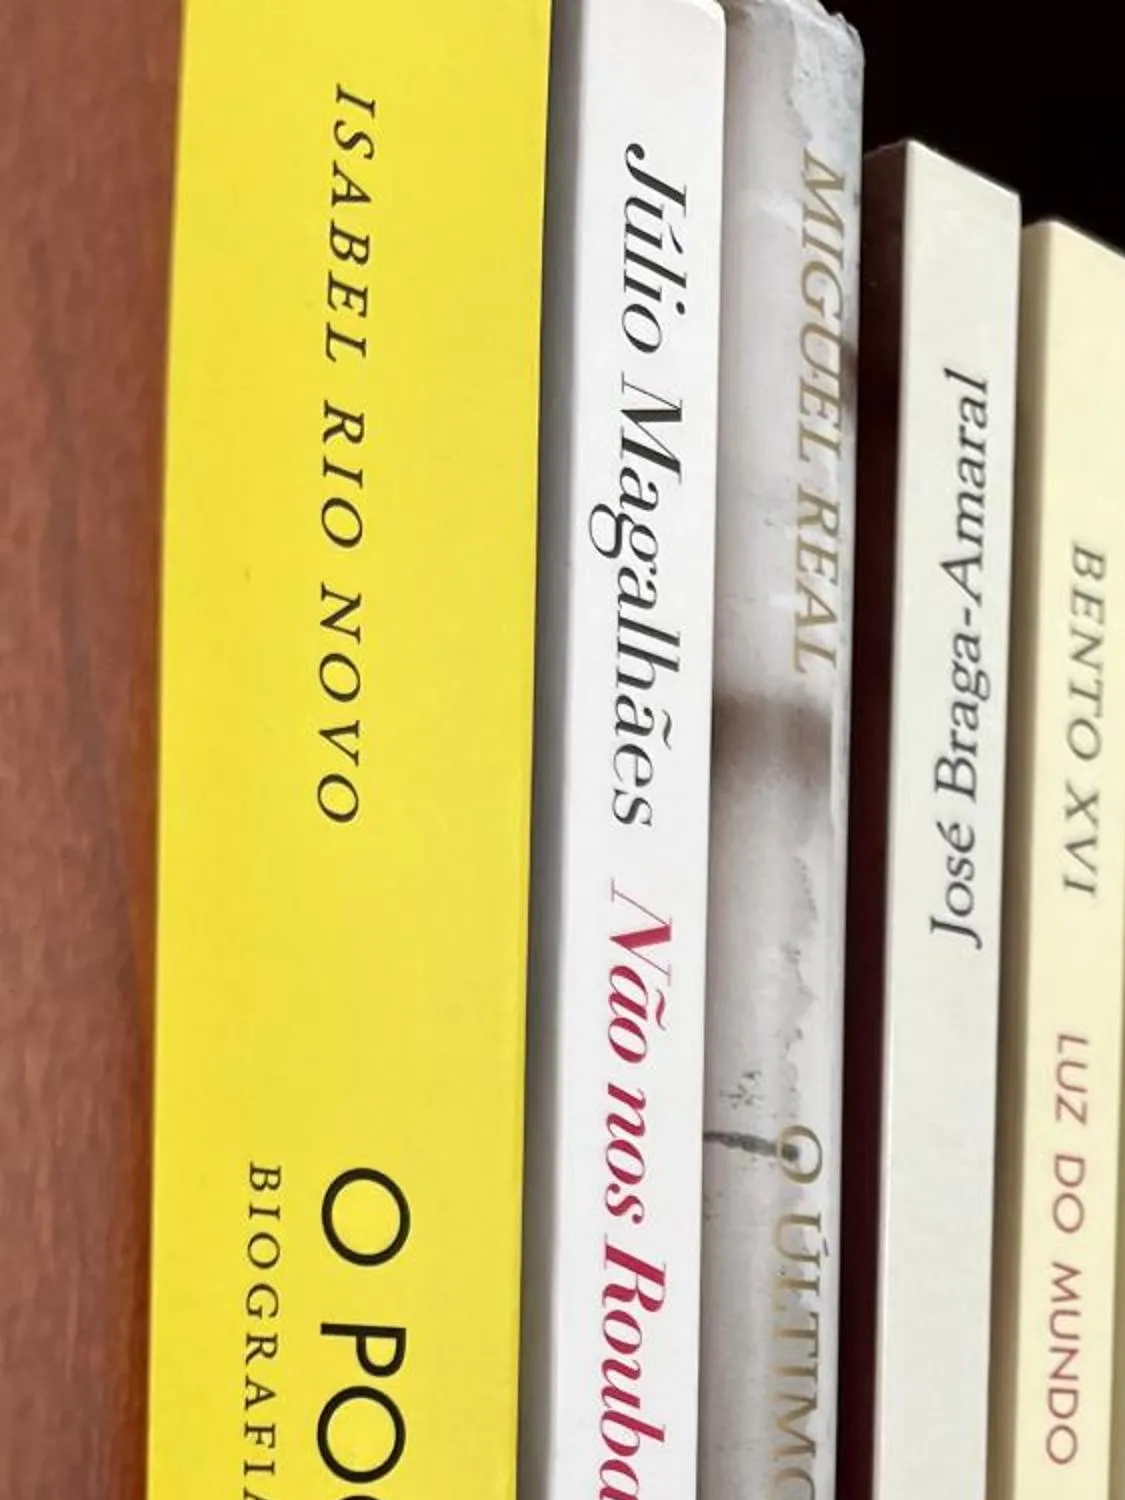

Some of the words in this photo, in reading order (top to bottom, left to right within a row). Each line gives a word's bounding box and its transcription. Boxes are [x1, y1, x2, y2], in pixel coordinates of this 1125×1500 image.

[325, 83, 377, 364] ISABEL
[620, 143, 687, 354] Júlio
[797, 148, 846, 462] MIGUEL
[320, 400, 364, 550] RIO
[588, 373, 683, 828] Magalhães
[792, 485, 840, 677] REAL
[934, 367, 990, 802] Braga-Amaral
[1065, 541, 1107, 763] BENTO
[316, 585, 361, 823] NOVO
[929, 820, 981, 950] José
[1062, 780, 1100, 898] XVI
[606, 878, 673, 1065] Não
[604, 1082, 648, 1225] nos
[775, 1124, 824, 1186] O
[1054, 1032, 1088, 1127] LUZ
[320, 1167, 411, 1267] O
[1051, 1153, 1084, 1234] DO
[1045, 1262, 1081, 1464] MUNDO
